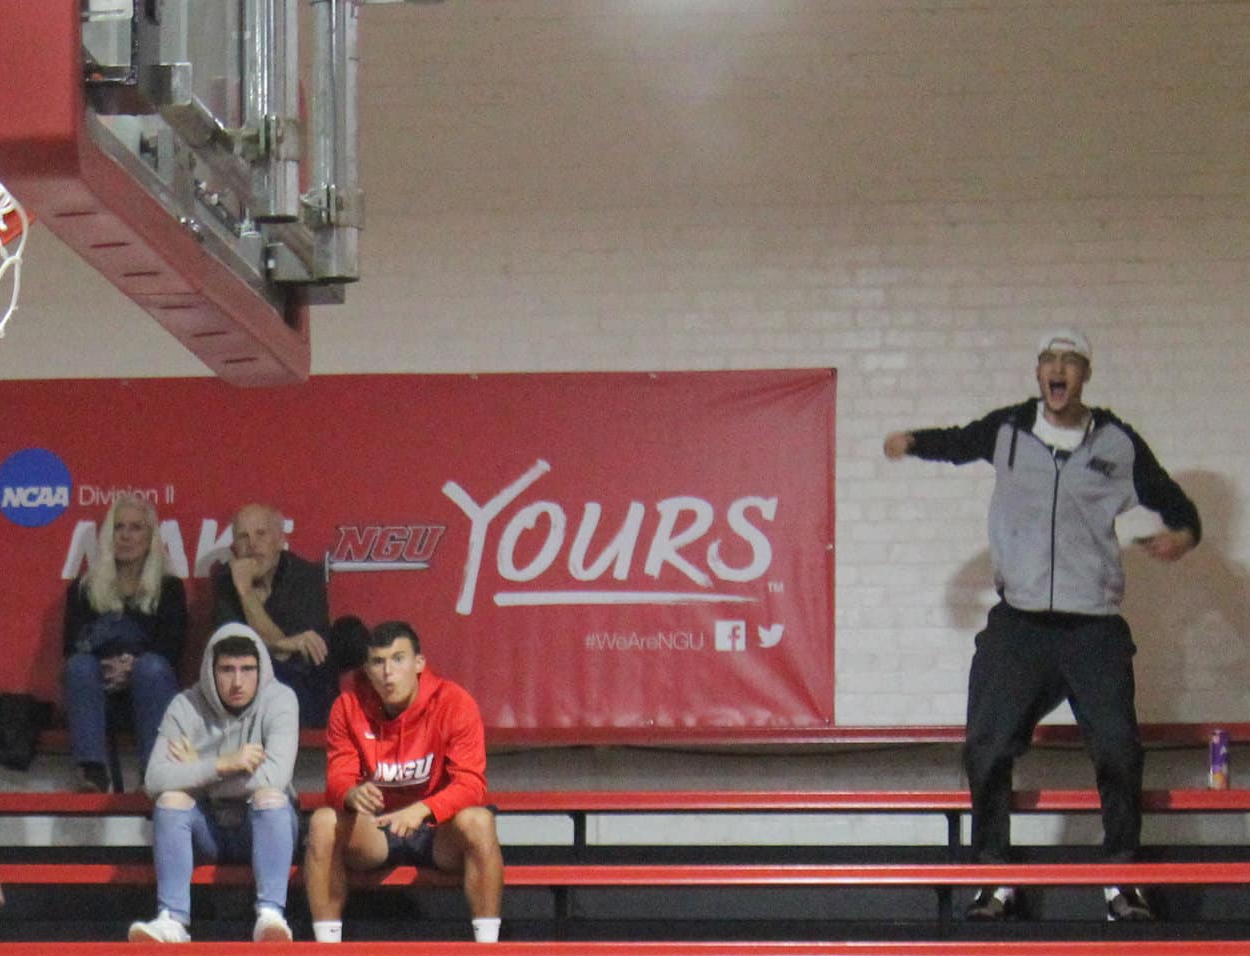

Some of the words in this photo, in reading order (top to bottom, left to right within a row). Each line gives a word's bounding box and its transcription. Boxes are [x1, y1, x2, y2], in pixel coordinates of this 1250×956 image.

[1, 486, 69, 508] NCAA
[334, 525, 446, 561] NGU
[441, 459, 778, 615] YOURS
[584, 632, 704, 650] #WeAreNGU
